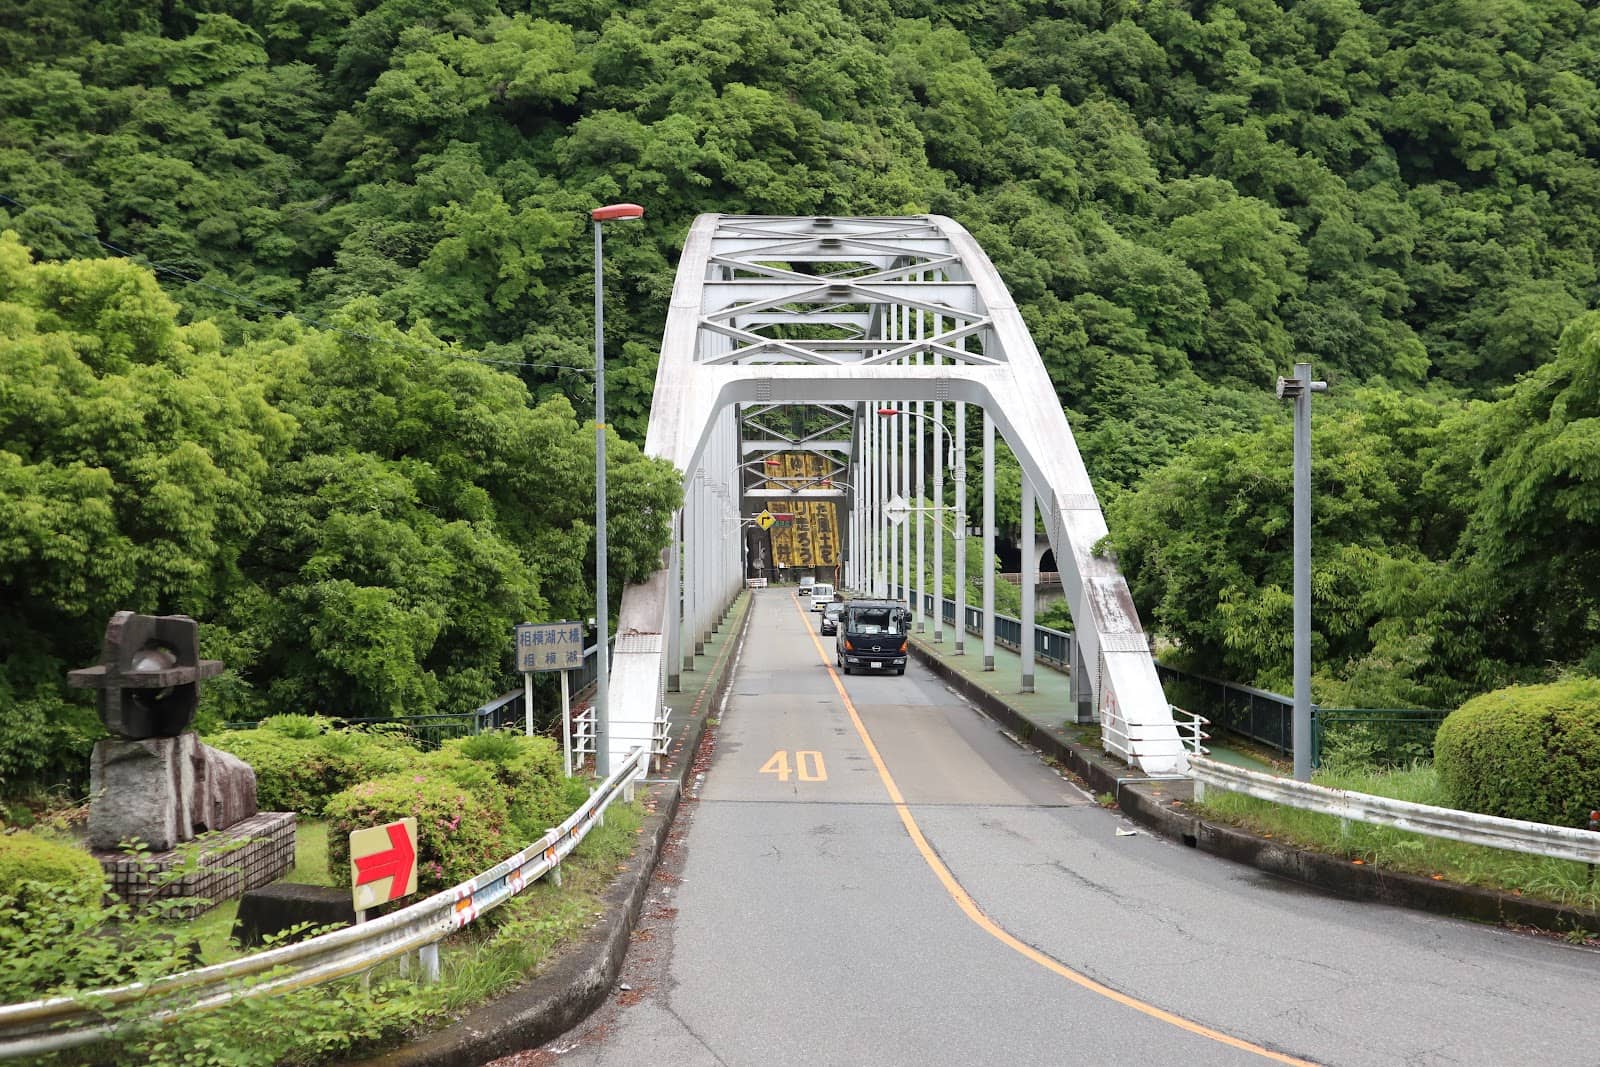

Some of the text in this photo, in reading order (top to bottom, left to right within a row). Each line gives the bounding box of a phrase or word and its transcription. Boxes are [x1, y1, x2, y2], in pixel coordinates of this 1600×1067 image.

[520, 628, 579, 647] 相模湖大橋
[758, 749, 828, 782] 40
